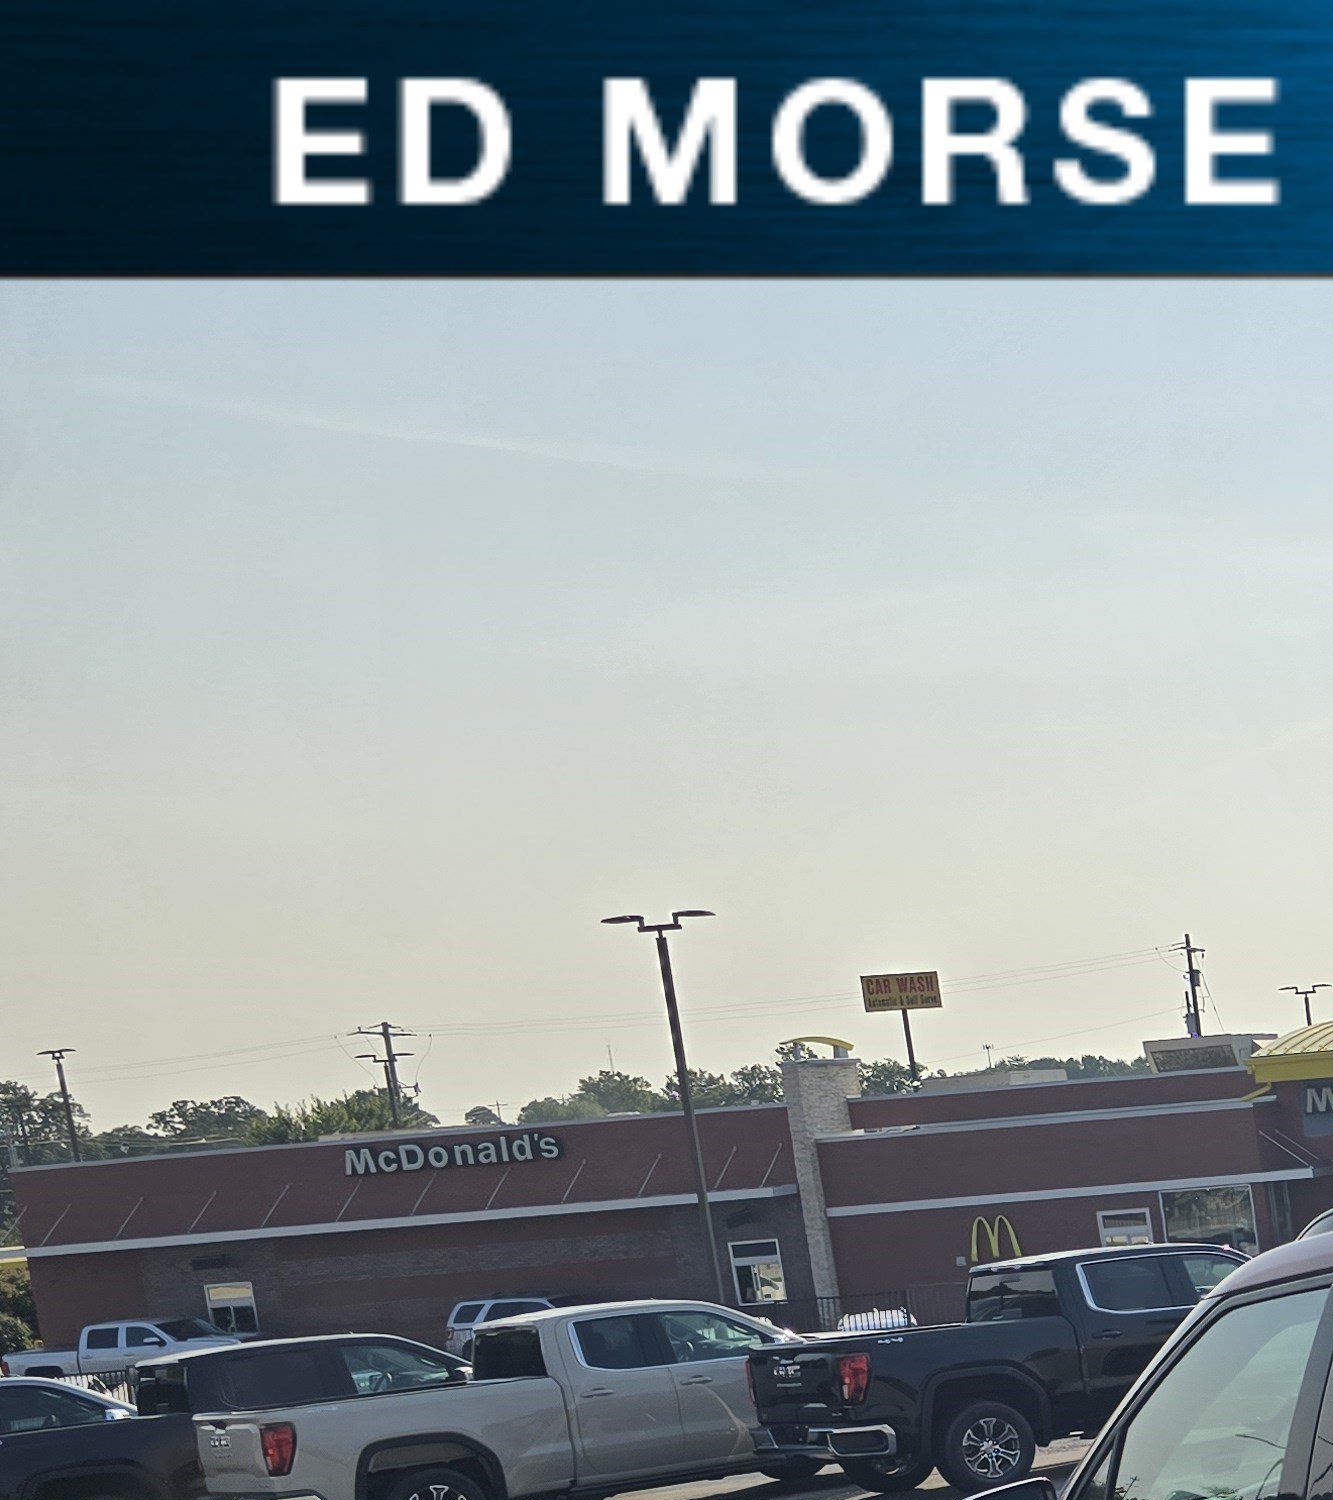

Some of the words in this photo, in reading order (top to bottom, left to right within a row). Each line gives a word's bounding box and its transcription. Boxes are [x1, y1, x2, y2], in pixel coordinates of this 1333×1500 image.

[866, 979, 892, 996] CAR
[896, 975, 935, 994] WASH
[344, 1133, 560, 1177] McDonald's
